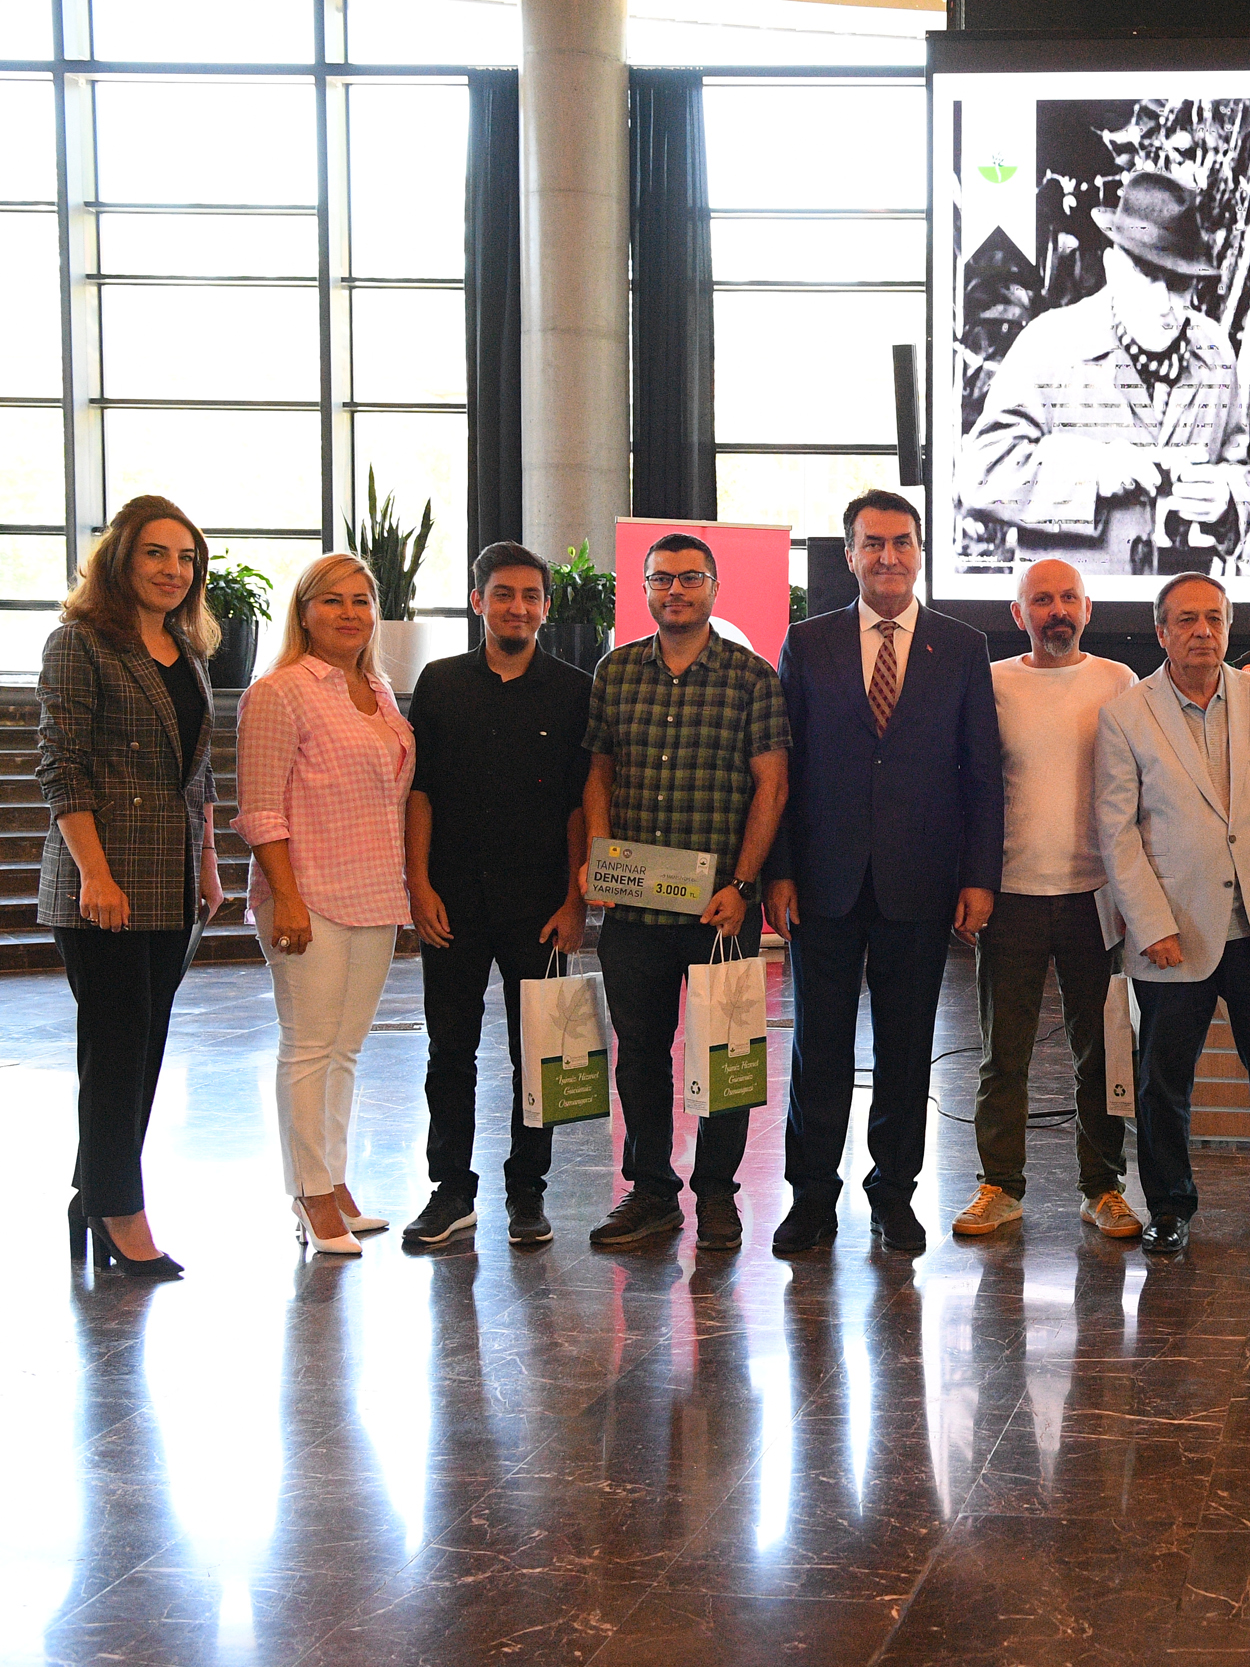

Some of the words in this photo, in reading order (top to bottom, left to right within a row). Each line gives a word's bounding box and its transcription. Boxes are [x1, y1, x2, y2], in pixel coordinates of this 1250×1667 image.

[596, 859, 647, 876] TANPINAR
[593, 871, 645, 888] DENEME
[592, 884, 643, 898] YARIŞMASI
[656, 883, 687, 897] 3.000
